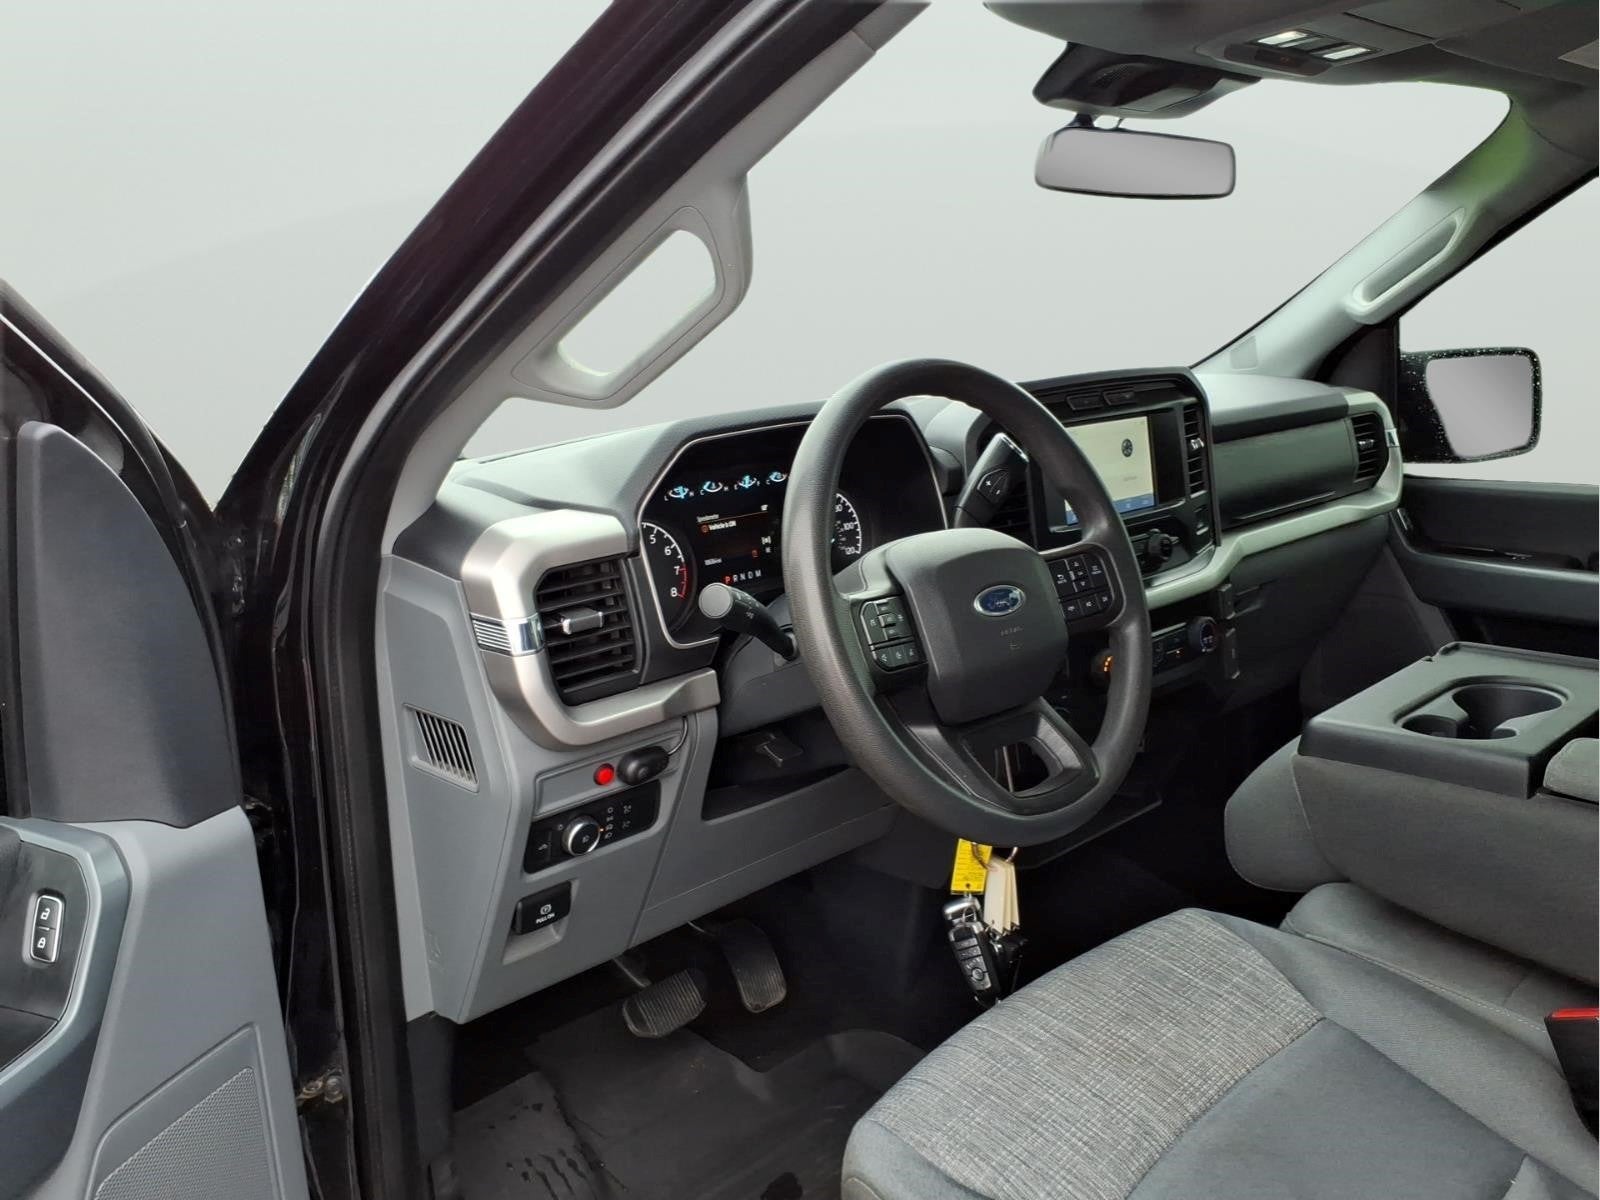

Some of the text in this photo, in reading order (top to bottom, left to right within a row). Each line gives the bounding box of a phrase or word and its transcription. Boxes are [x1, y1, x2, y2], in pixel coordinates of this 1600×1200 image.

[649, 534, 656, 544] 5
[664, 546, 672, 556] 6
[674, 565, 680, 575] 7
[725, 576, 731, 584] P
[733, 574, 738, 582] R
[670, 587, 678, 597] 8
